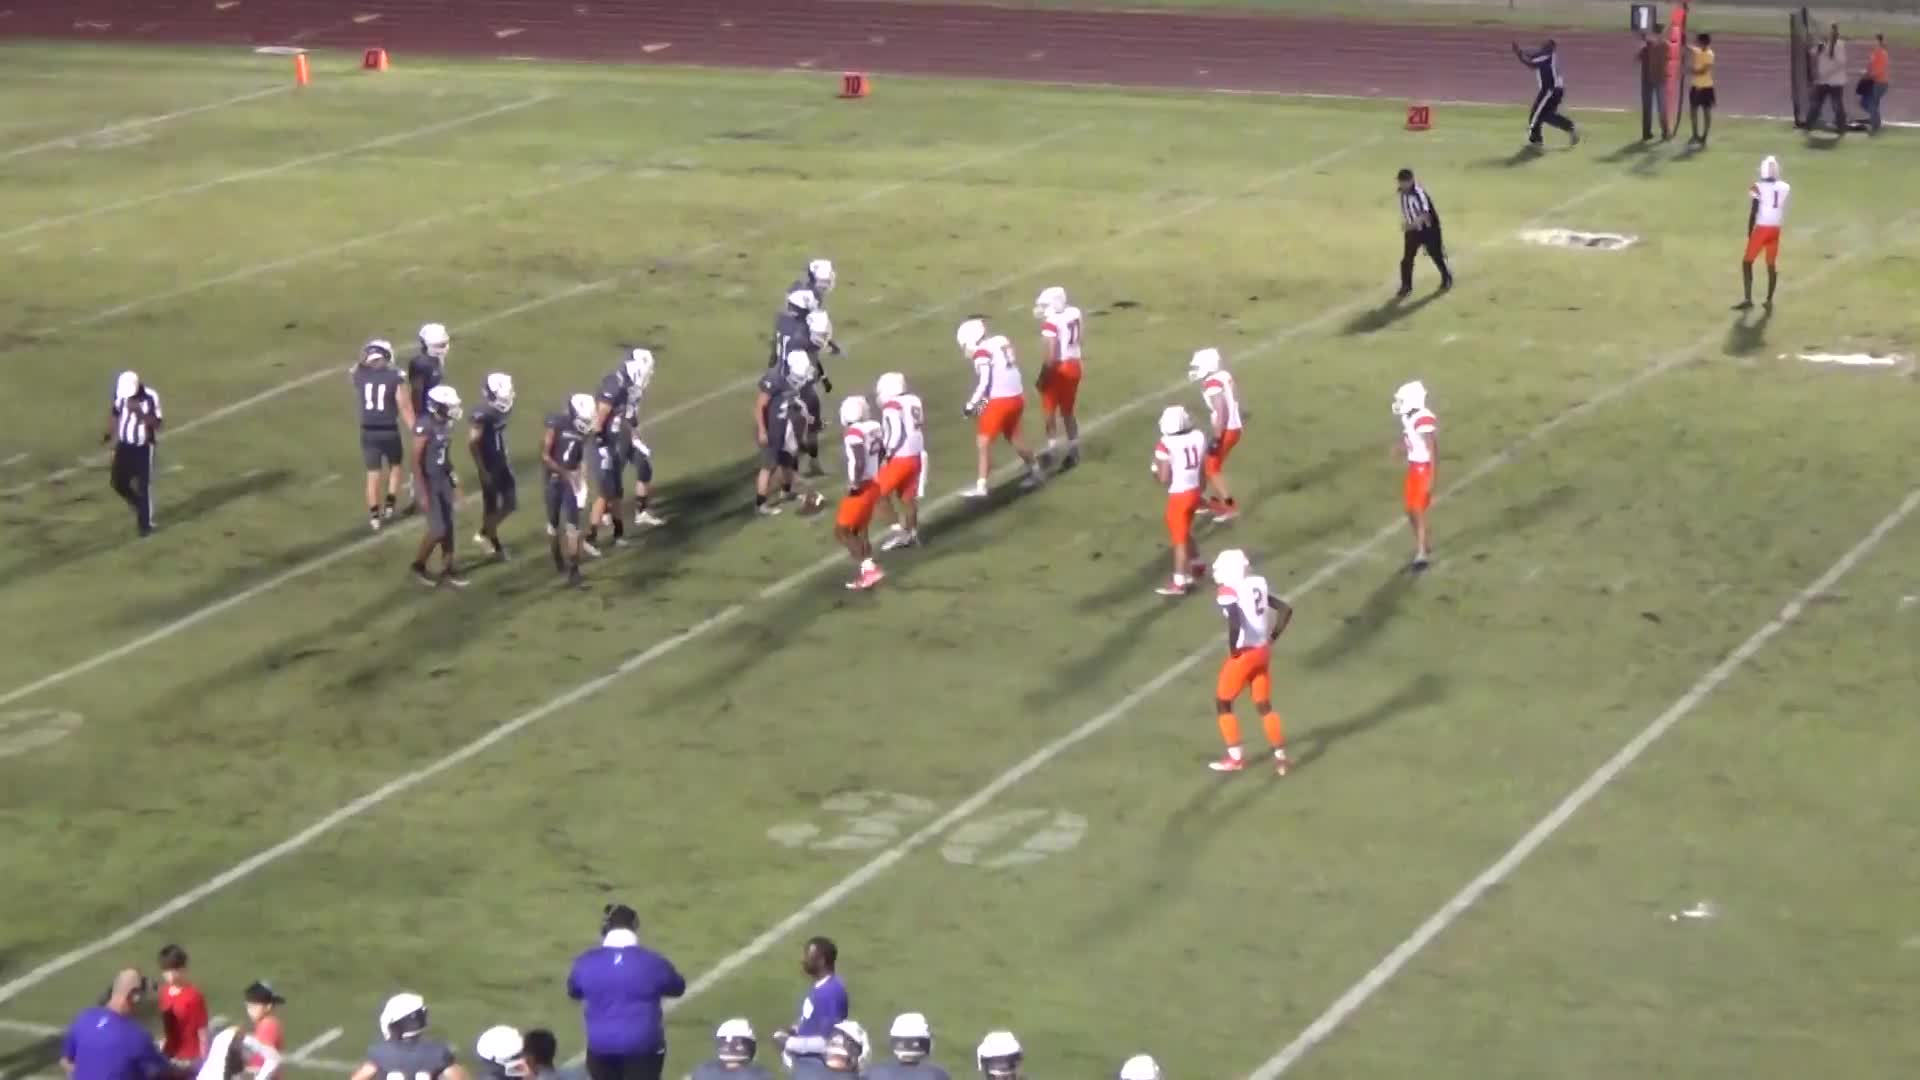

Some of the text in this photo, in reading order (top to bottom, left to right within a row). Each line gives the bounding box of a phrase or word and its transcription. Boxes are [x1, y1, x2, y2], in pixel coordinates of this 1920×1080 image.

[1638, 6, 1649, 29] 1
[844, 75, 861, 94] 10
[1409, 106, 1428, 125] 20
[1772, 190, 1779, 209] 1
[364, 383, 386, 411] 11
[1183, 446, 1199, 470] 11
[1252, 588, 1266, 616] 2
